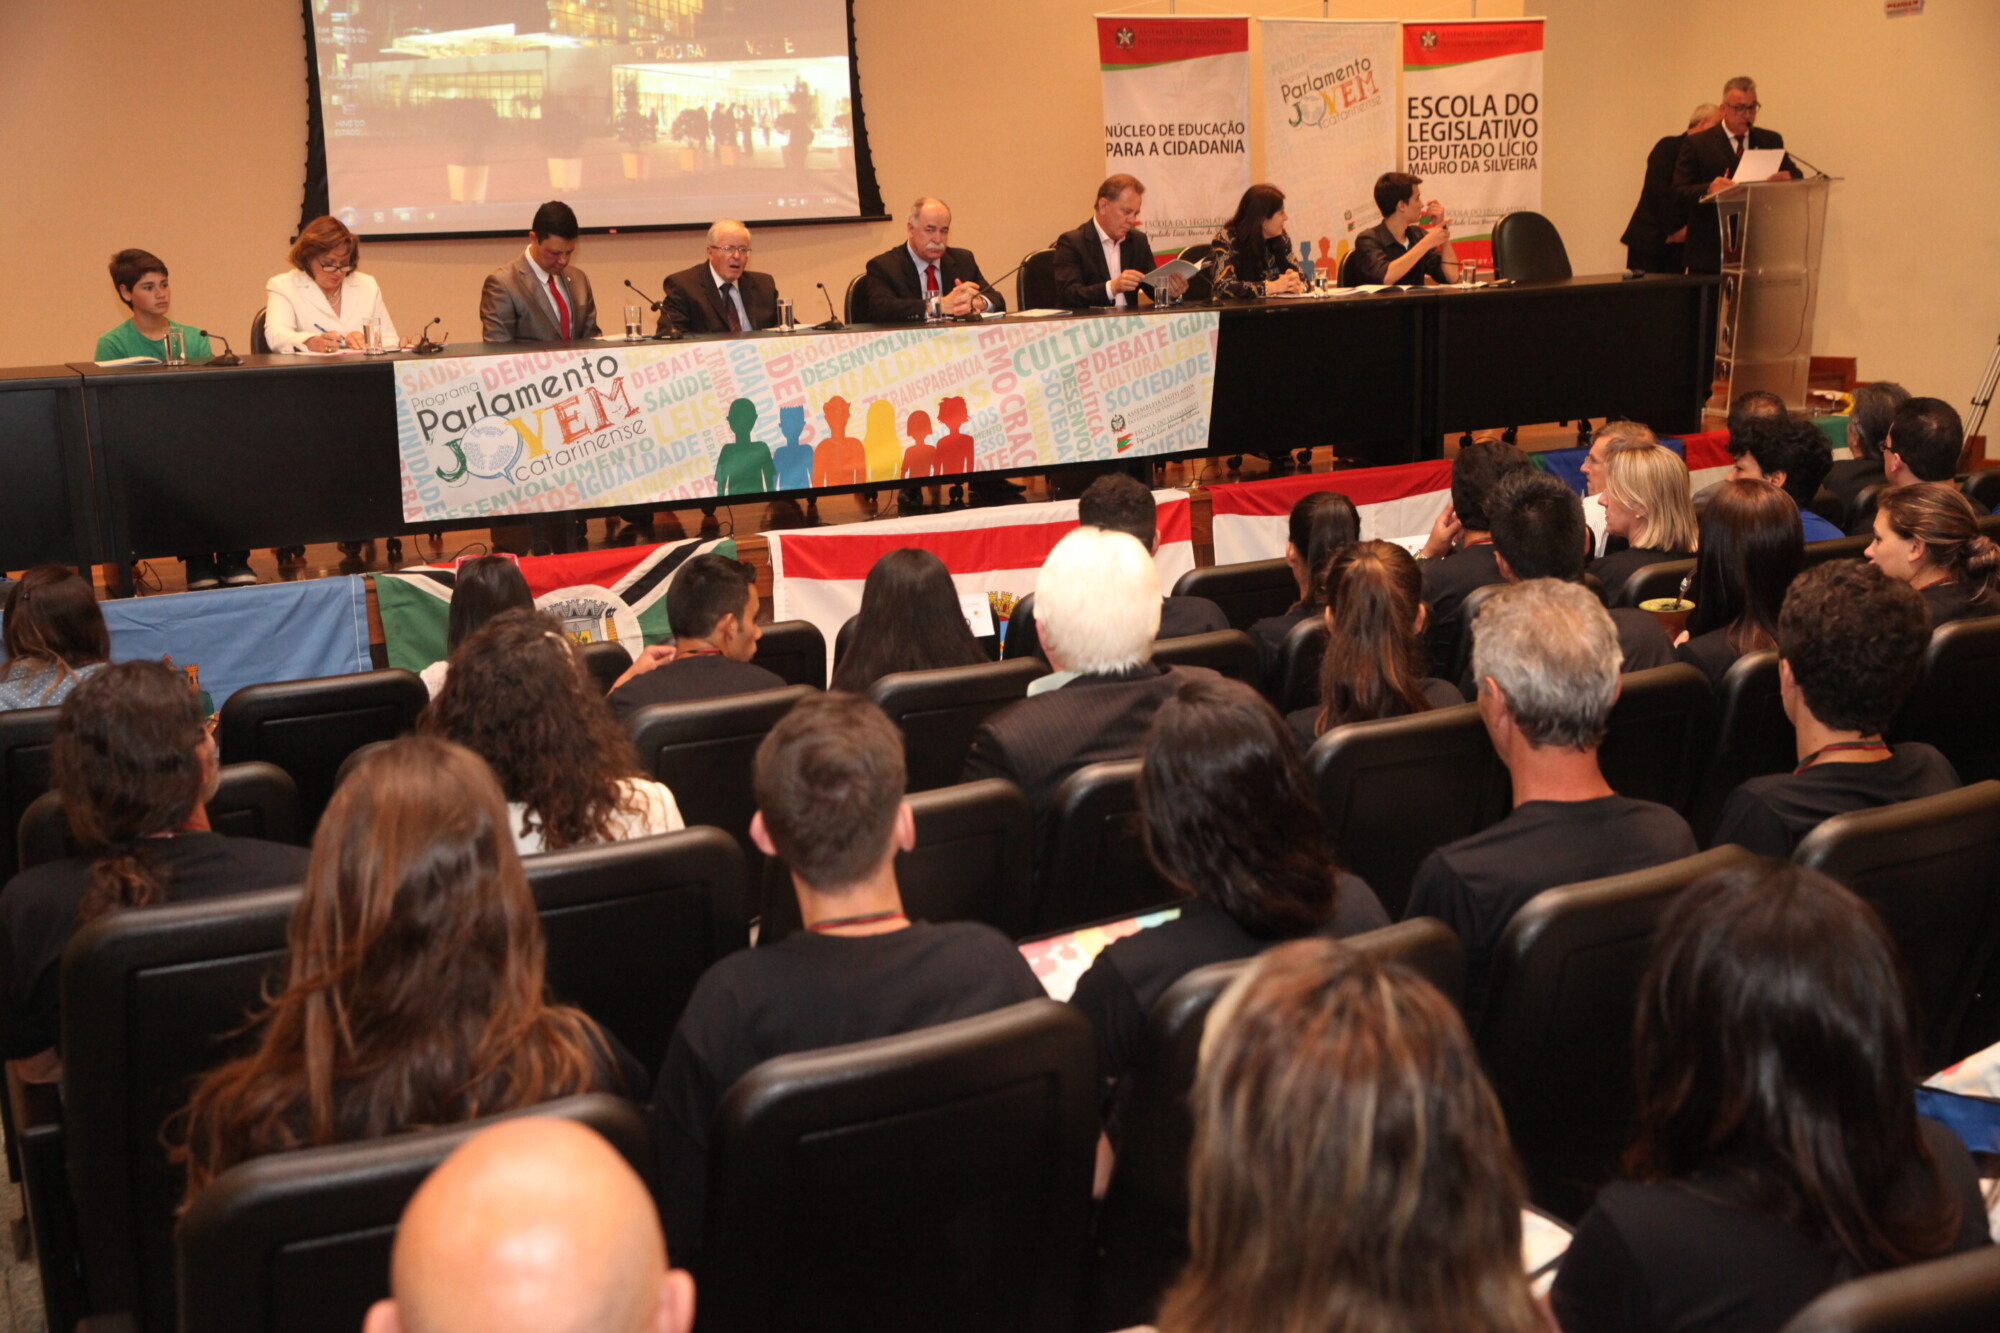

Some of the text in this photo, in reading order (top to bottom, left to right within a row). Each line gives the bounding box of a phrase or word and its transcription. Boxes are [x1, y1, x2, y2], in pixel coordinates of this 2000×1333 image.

[1281, 57, 1372, 104] Parlamento
[1288, 70, 1380, 129] JOVEM
[1322, 95, 1382, 129] catarinense
[1407, 92, 1539, 119] ESCOLA DO
[1105, 120, 1245, 138] NÚCLEO DE EDUCAÇÃO
[1105, 139, 1245, 157] PARA A CIDADANIA
[1407, 118, 1539, 142] LEGISLATIVO
[1407, 138, 1538, 161] DEPUTADO LÍCIO
[1407, 157, 1538, 176] MAURO DA SILVEIRA
[1013, 315, 1145, 377] CULTURA
[1092, 325, 1169, 374] DEBATE
[1163, 334, 1206, 367] LEIS
[630, 347, 706, 391] DEBATE
[643, 369, 713, 413] SAÚDE
[882, 355, 984, 408] TRANSPARÊNCIA
[1099, 353, 1163, 392] CULTURA
[1105, 351, 1211, 413] SOCIEDADE
[411, 381, 480, 411] Programa
[417, 355, 618, 441] Parlamento
[651, 391, 722, 446] LEIS
[1075, 357, 1105, 439] POLÍTICA
[435, 376, 641, 488] JOVEM
[515, 419, 647, 482] catarinense
[576, 433, 702, 500] IGUALDADE
